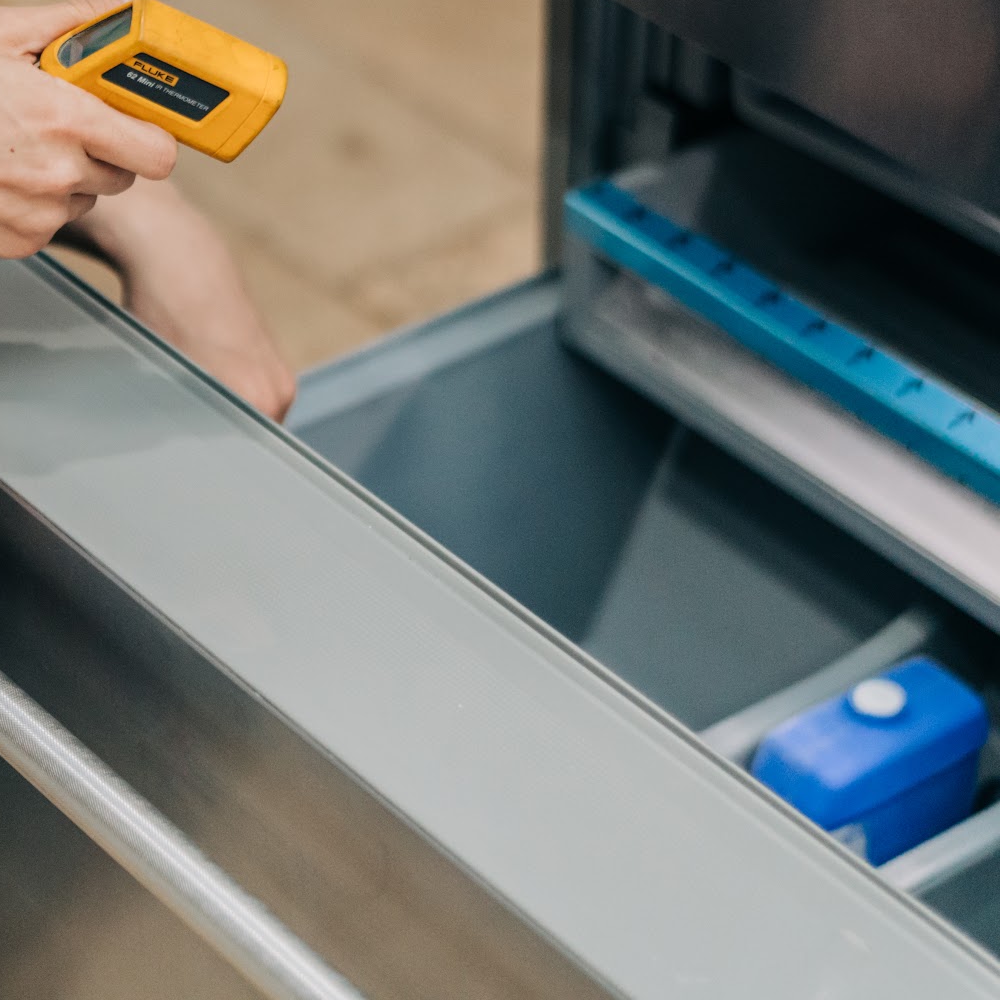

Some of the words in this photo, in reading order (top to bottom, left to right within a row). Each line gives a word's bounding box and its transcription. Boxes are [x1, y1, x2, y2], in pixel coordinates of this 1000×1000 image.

[133, 61, 175, 84] FLUKE
[126, 71, 138, 80] 62
[137, 76, 156, 88] Mini
[163, 87, 210, 111] THERMOMETER
